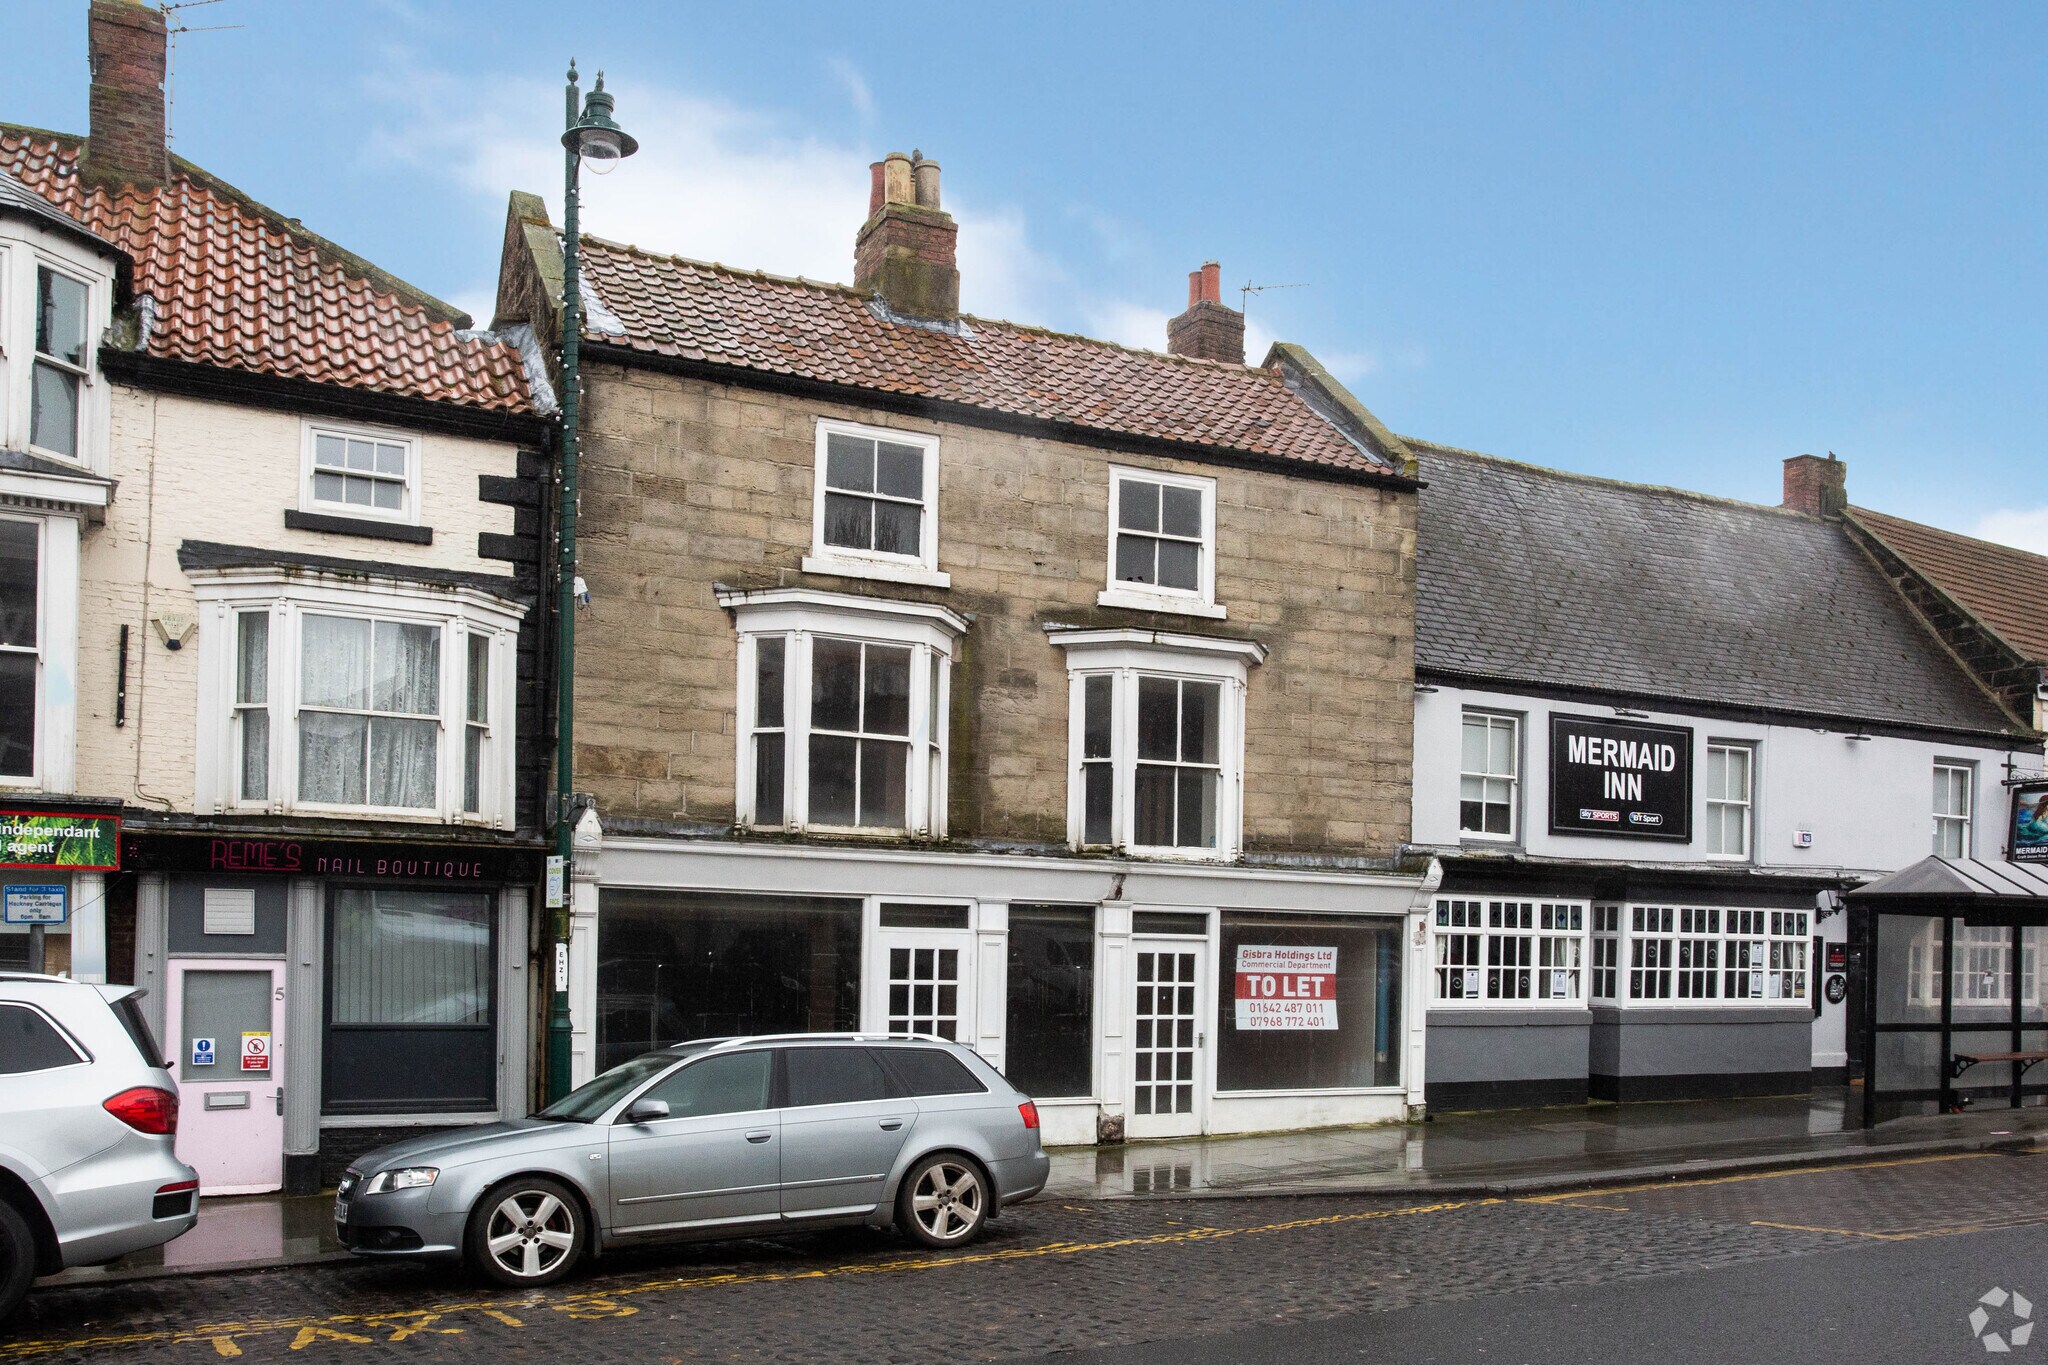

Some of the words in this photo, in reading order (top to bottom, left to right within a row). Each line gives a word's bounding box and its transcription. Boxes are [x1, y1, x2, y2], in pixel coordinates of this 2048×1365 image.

[1568, 735, 1675, 772] MERMAID
[1604, 771, 1642, 801] INN
[1581, 810, 1591, 819] sky
[1592, 811, 1618, 820] SPORTS
[1643, 815, 1659, 823] Sport
[0, 823, 100, 838] independant
[7, 841, 54, 855] agent
[211, 840, 302, 869] REME'S
[317, 857, 364, 874] NAIL
[377, 859, 481, 878] BOUTIQUE
[1242, 949, 1272, 959] Gisbra
[1274, 950, 1315, 961] Holdings
[1317, 951, 1332, 960] Ltd
[1241, 960, 1286, 968] Commercial
[1287, 961, 1331, 970] Department
[1246, 975, 1277, 997] TO
[1283, 975, 1325, 997] LET
[274, 987, 285, 1001] 5
[1249, 1003, 1281, 1013] 01642
[1284, 1003, 1303, 1013] 487
[1305, 1003, 1324, 1013] 011
[1250, 1017, 1282, 1026] 07968
[1284, 1017, 1304, 1027] 772
[1307, 1017, 1325, 1026] 401
